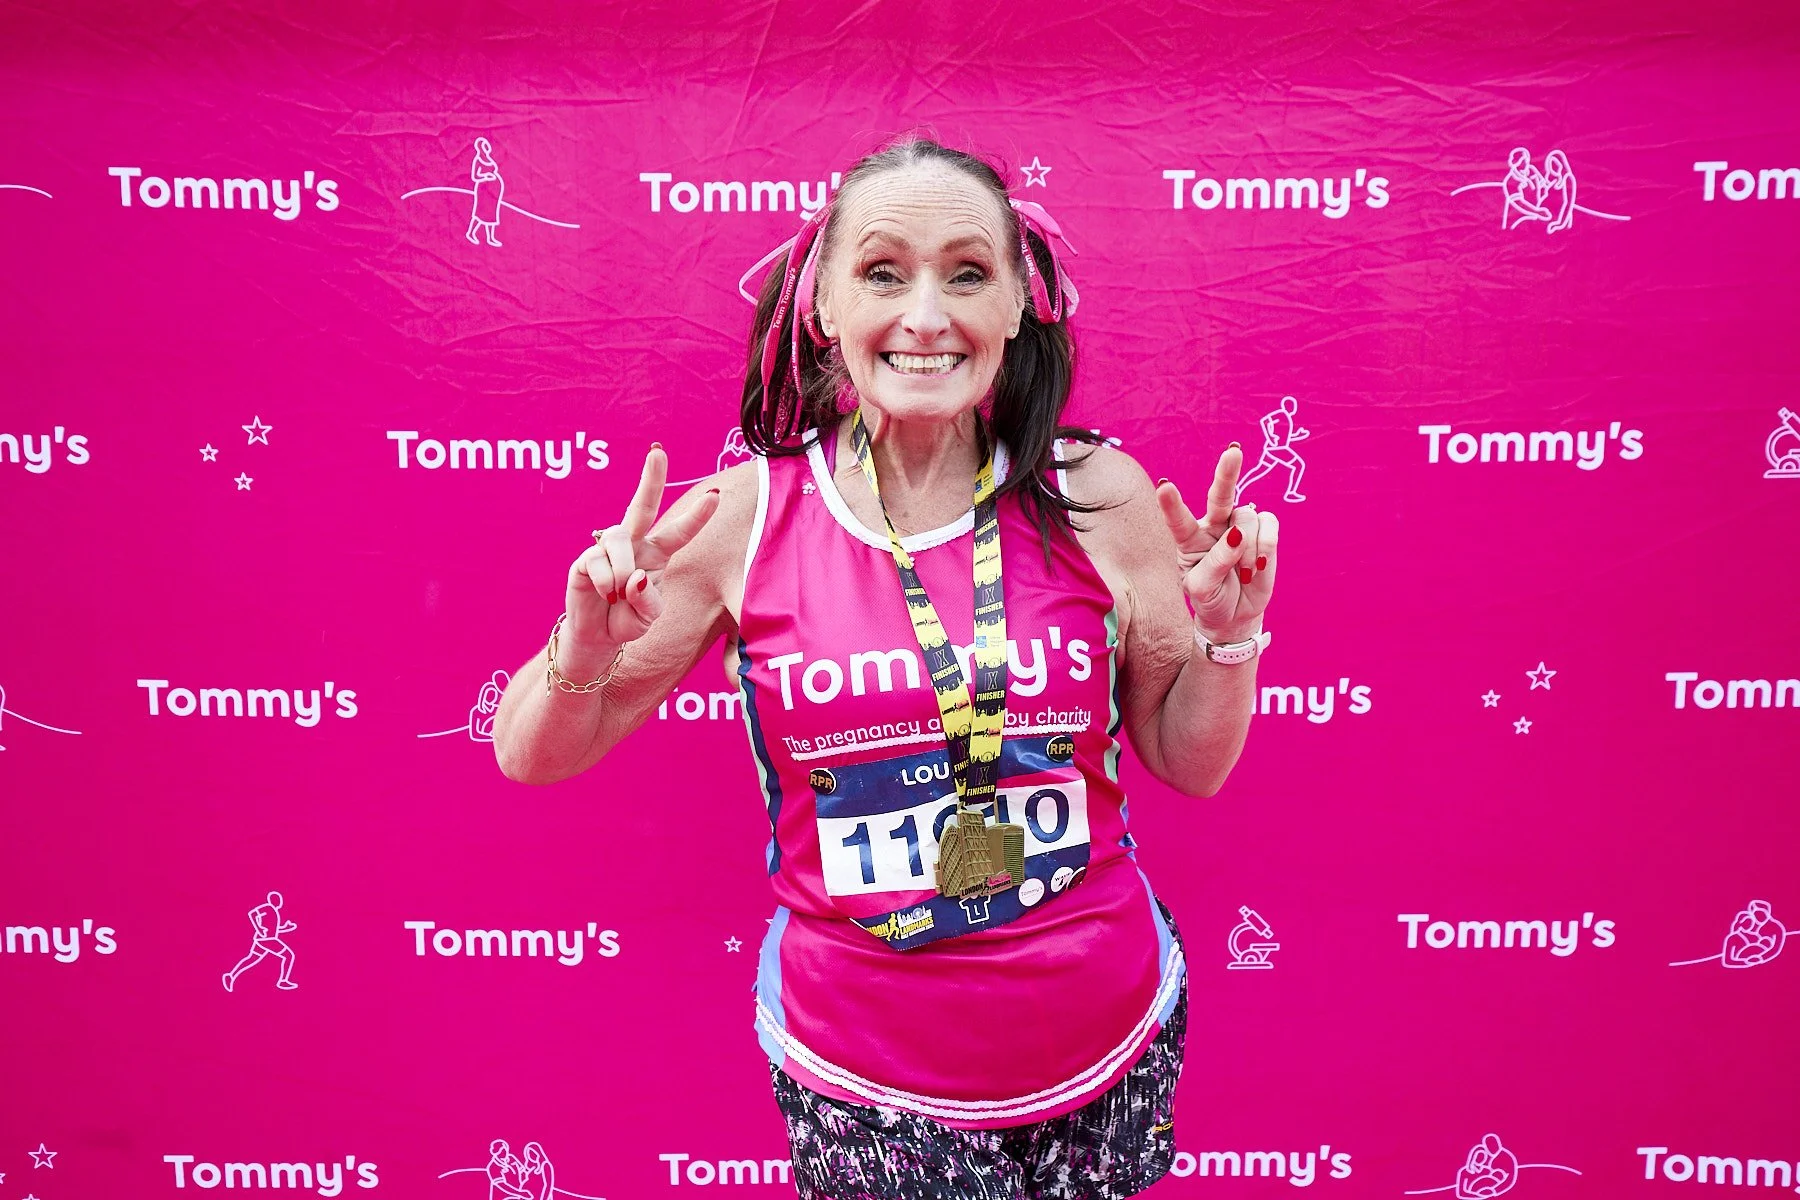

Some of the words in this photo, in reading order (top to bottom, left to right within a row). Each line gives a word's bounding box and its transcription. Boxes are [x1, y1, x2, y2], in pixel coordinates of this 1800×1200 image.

[108, 166, 340, 221] Tommy's
[639, 171, 842, 222] Tommy'
[1162, 168, 1390, 219] Tommy's
[773, 305, 786, 329] Team
[780, 267, 796, 305] Tommy's
[386, 430, 610, 480] Tommy's
[1418, 421, 1644, 471] Tommy's
[975, 601, 1003, 616] FINISHER
[931, 663, 960, 682] FINISHER
[136, 679, 358, 728] Tommy's
[976, 690, 1005, 702] FINISHER
[1251, 677, 1372, 724] my's
[782, 735, 811, 753] The
[815, 719, 922, 751] pregnancy
[1004, 708, 1030, 728] by
[1035, 706, 1092, 727] charity
[1050, 742, 1075, 755] RPR
[810, 773, 833, 790] RPR
[902, 761, 950, 786] LOU
[953, 760, 969, 773] FINIS
[966, 784, 996, 797] FINISHER
[961, 882, 984, 897] LONDON
[0, 918, 117, 963] my's
[403, 920, 621, 967] Tommy's
[866, 922, 890, 936] NDON
[900, 916, 934, 935] LANDMARKS
[1397, 911, 1616, 957] Tommy's
[163, 1155, 379, 1198] Tommy's
[1170, 1144, 1352, 1187] ommy's
[1636, 1146, 1800, 1195] Tomm
